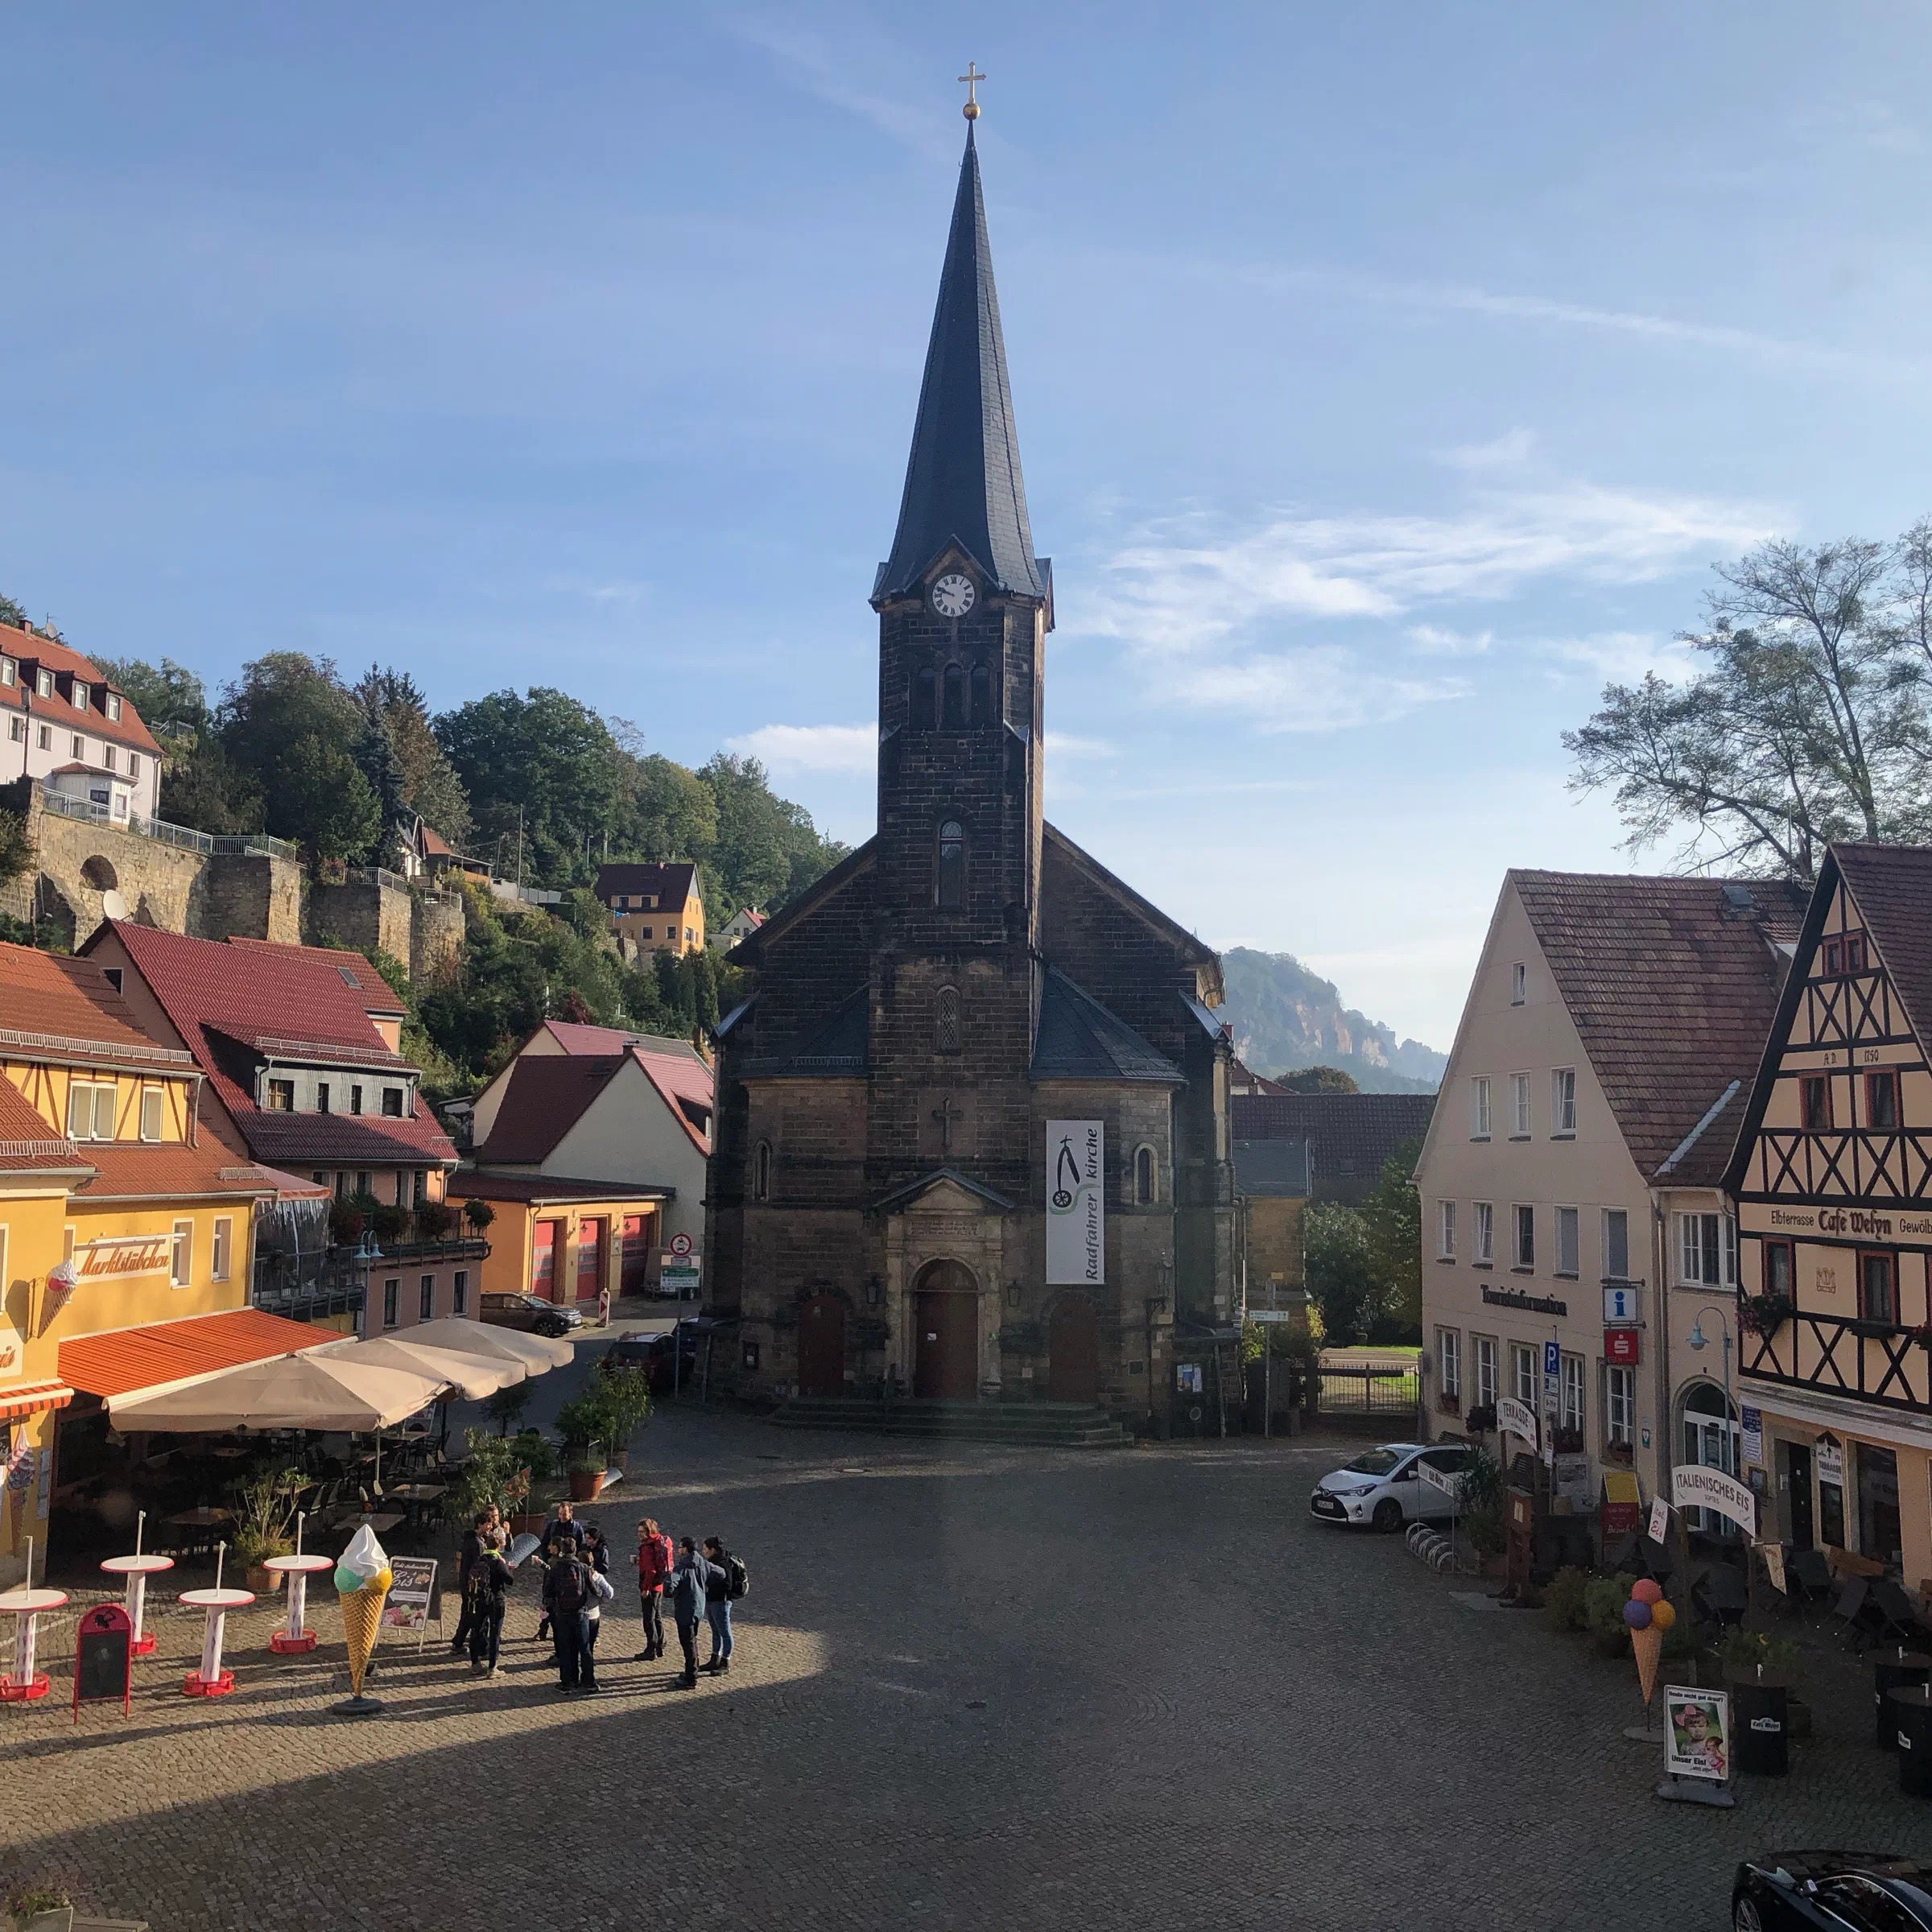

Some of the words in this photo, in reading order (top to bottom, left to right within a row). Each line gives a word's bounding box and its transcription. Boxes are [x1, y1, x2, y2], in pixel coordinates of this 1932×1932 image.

[1864, 1049, 1879, 1063] 1750
[1085, 1128, 1098, 1179] kirche
[1771, 1210, 1814, 1227] Elbterrasse
[1085, 1193, 1100, 1281] Radfahrer
[76, 1243, 169, 1277] Marktstübchen
[1676, 1473, 1735, 1502] ITALIENISCHES
[1736, 1491, 1749, 1512] EIS
[391, 1570, 414, 1587] Eis
[1671, 1754, 1692, 1764] Unser
[1694, 1757, 1707, 1766] Eis!
